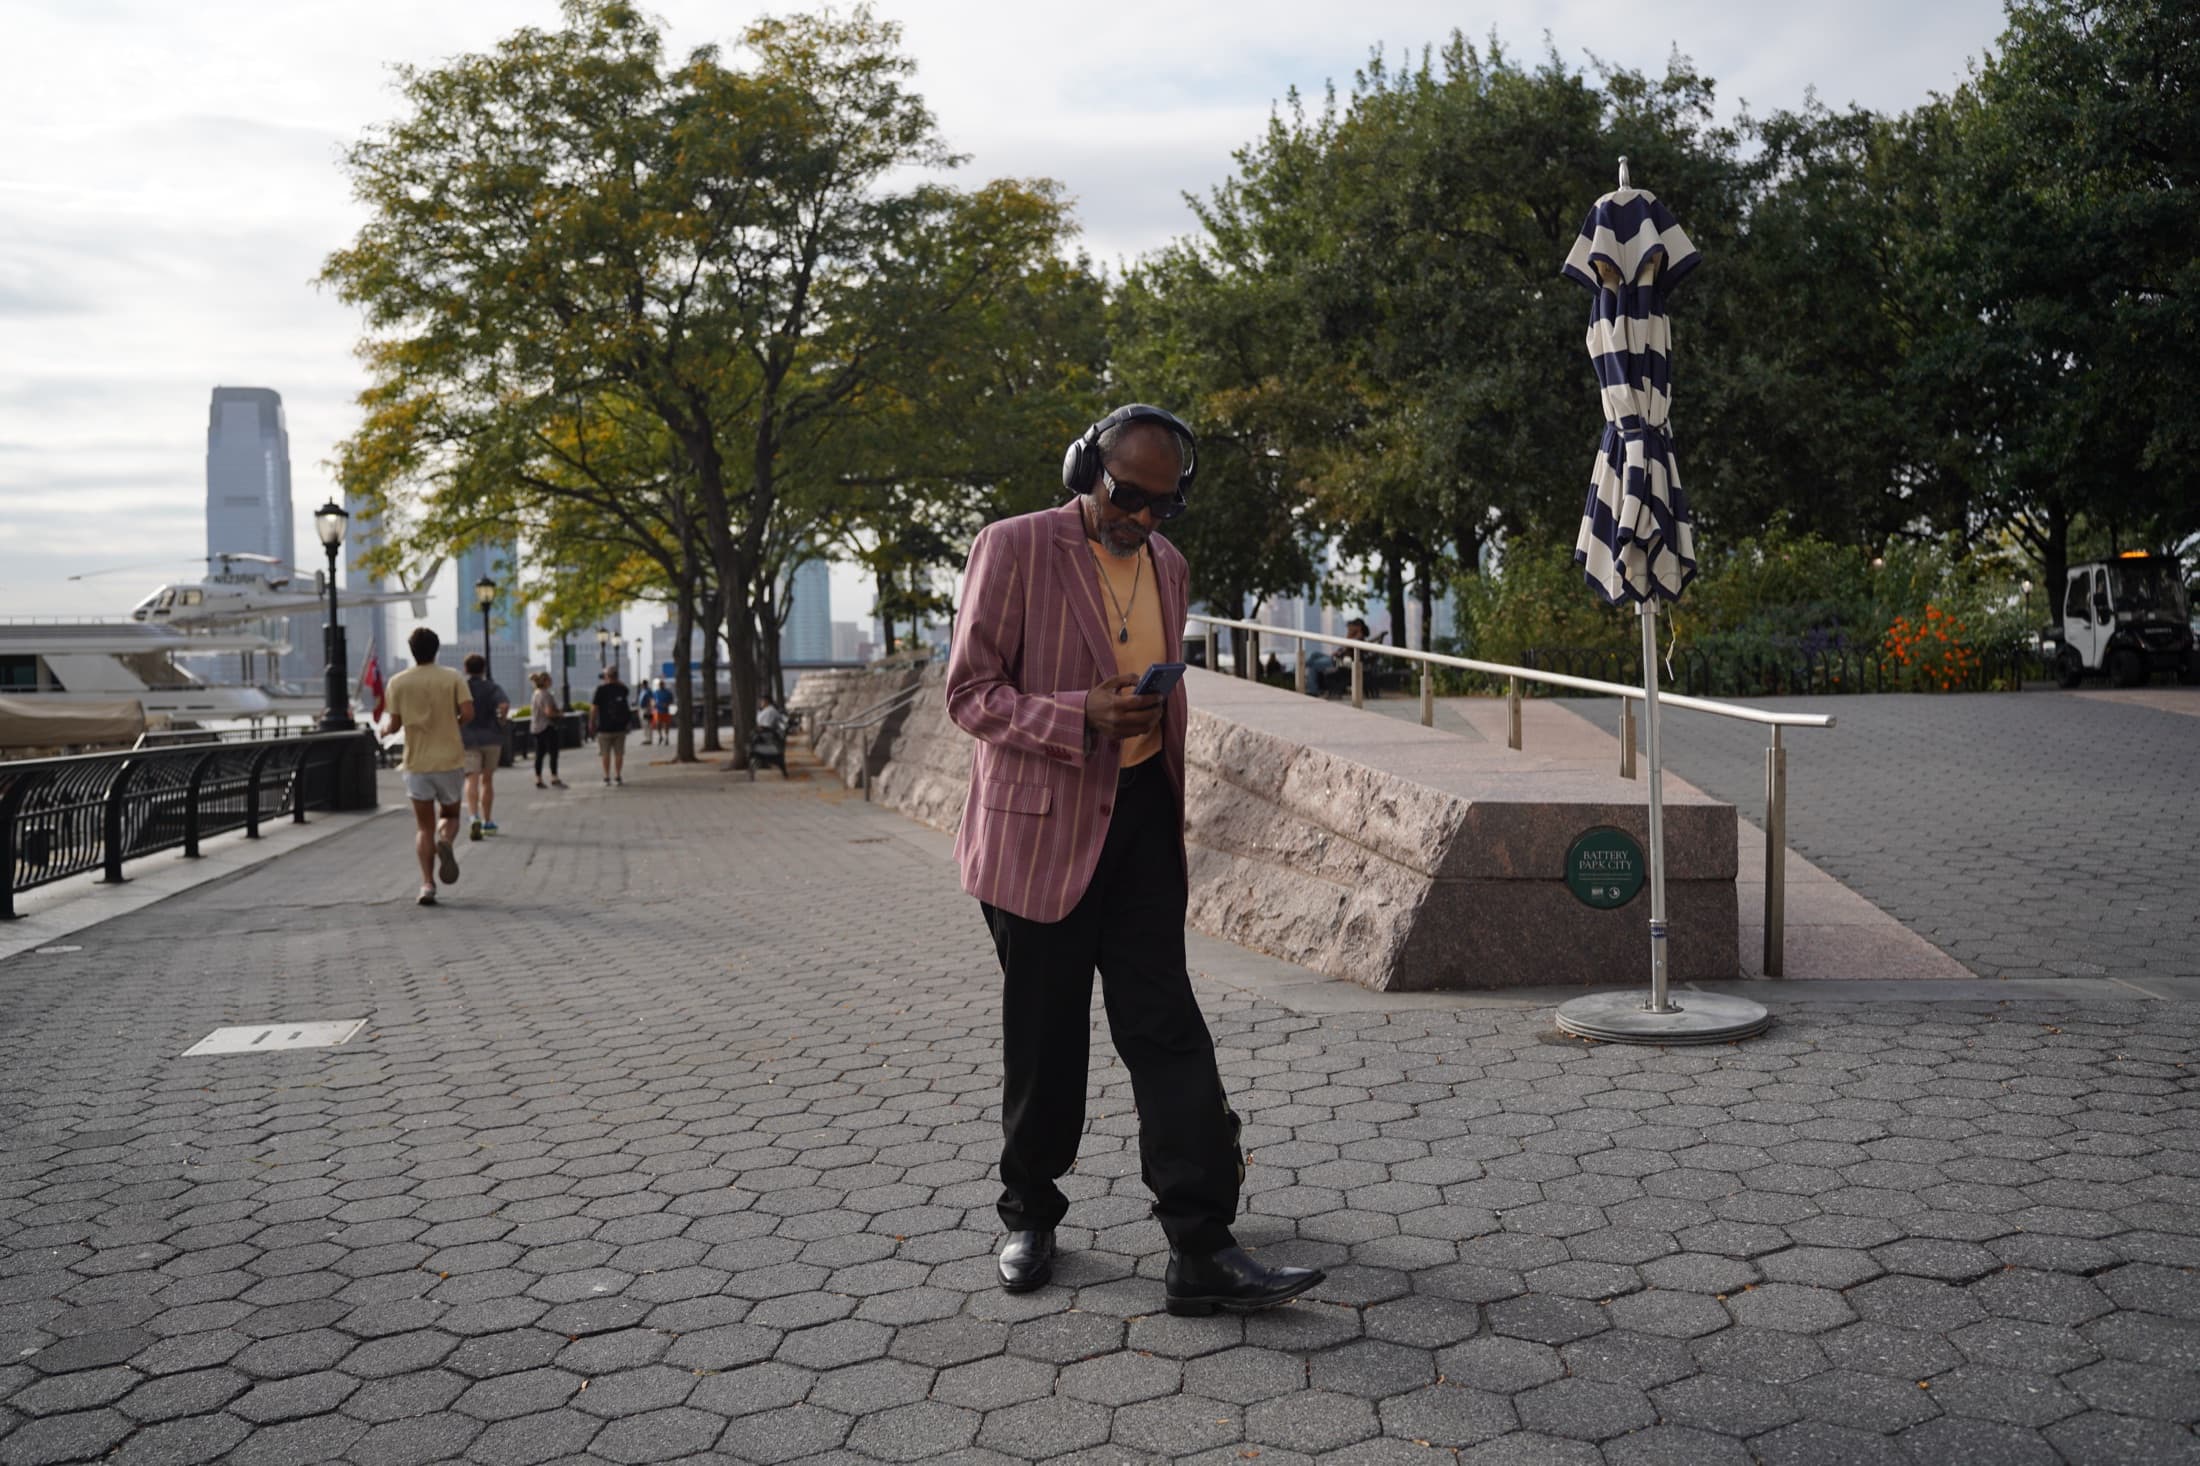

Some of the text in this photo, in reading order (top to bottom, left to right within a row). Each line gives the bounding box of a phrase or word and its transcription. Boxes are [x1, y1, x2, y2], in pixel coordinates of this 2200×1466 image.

[1583, 850, 1629, 860] BATTERY
[1579, 860, 1632, 870] PARK CITY
